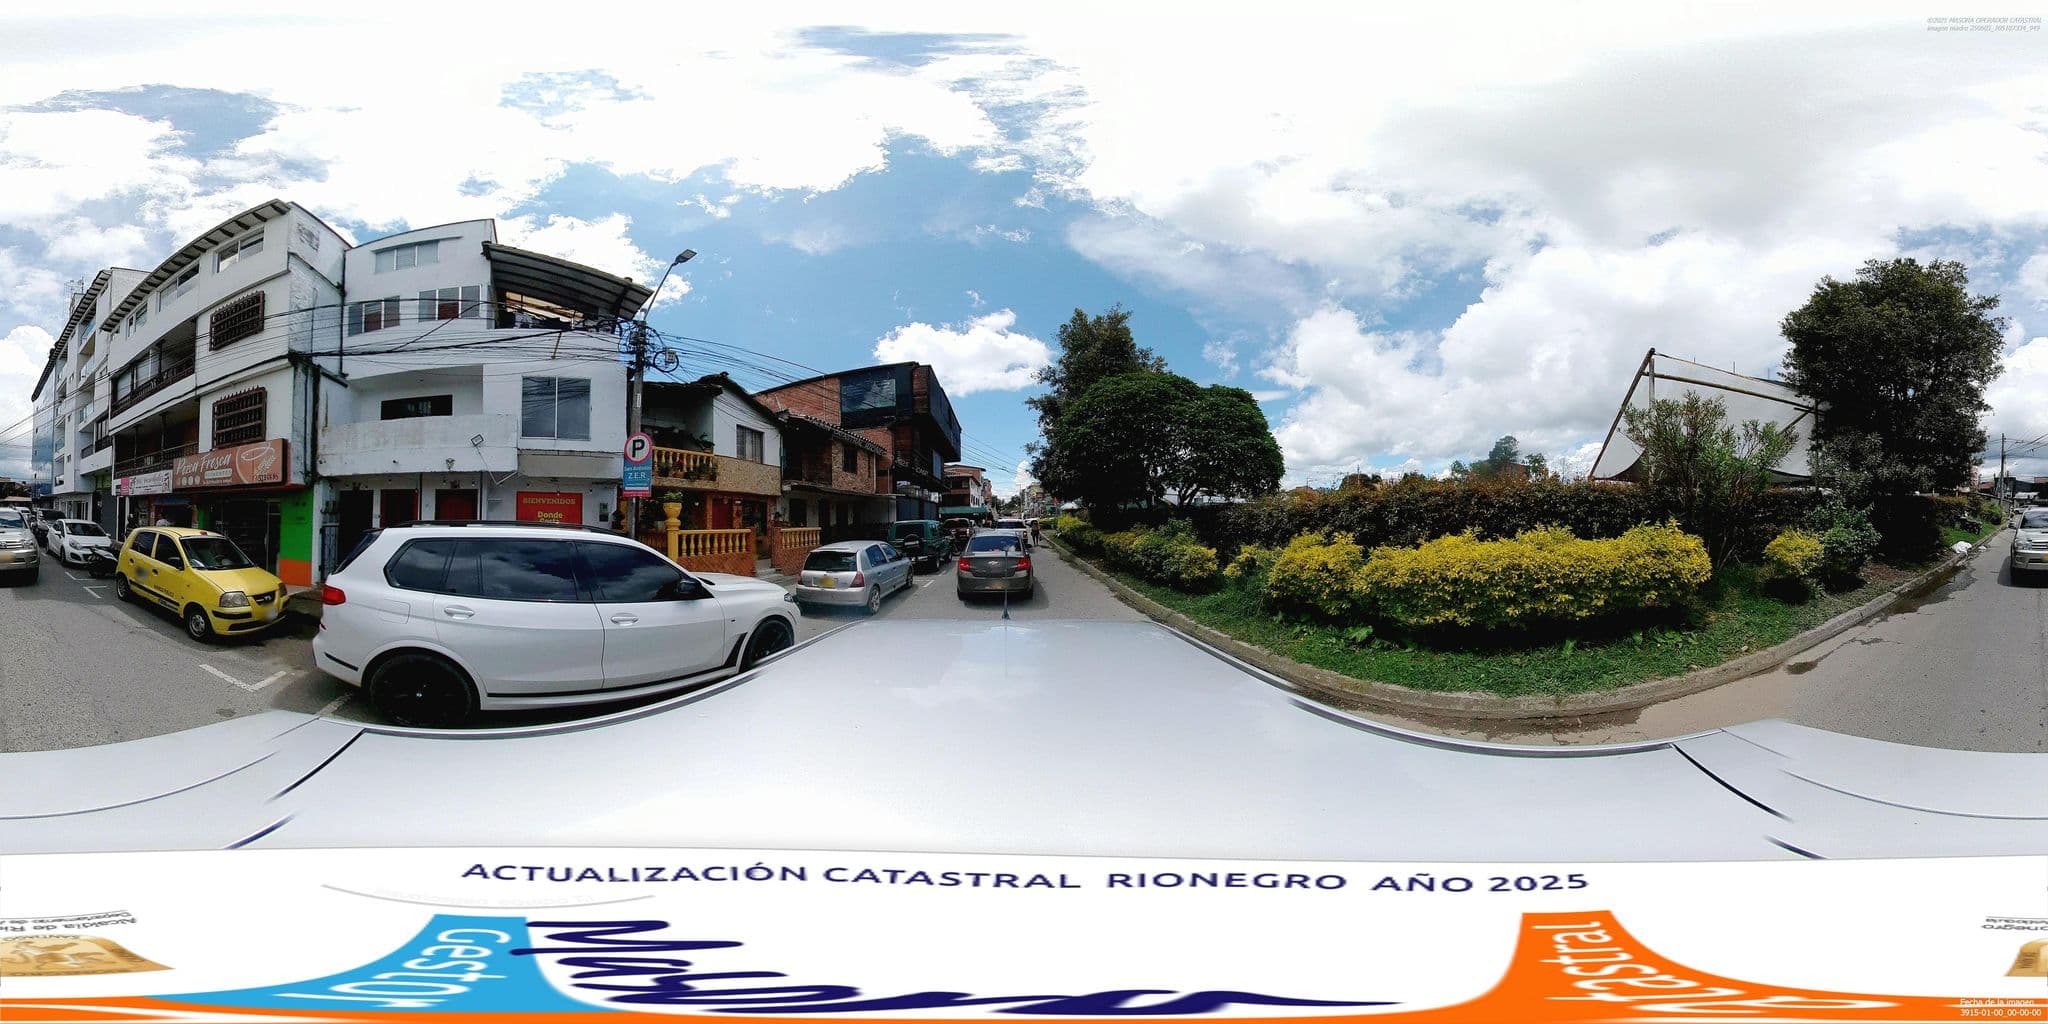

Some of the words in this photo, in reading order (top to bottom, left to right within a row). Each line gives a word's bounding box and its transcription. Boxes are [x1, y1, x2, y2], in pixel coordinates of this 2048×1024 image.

[632, 439, 645, 458] P
[522, 497, 576, 505] BIENVENIDOS
[537, 511, 564, 519] Donde
